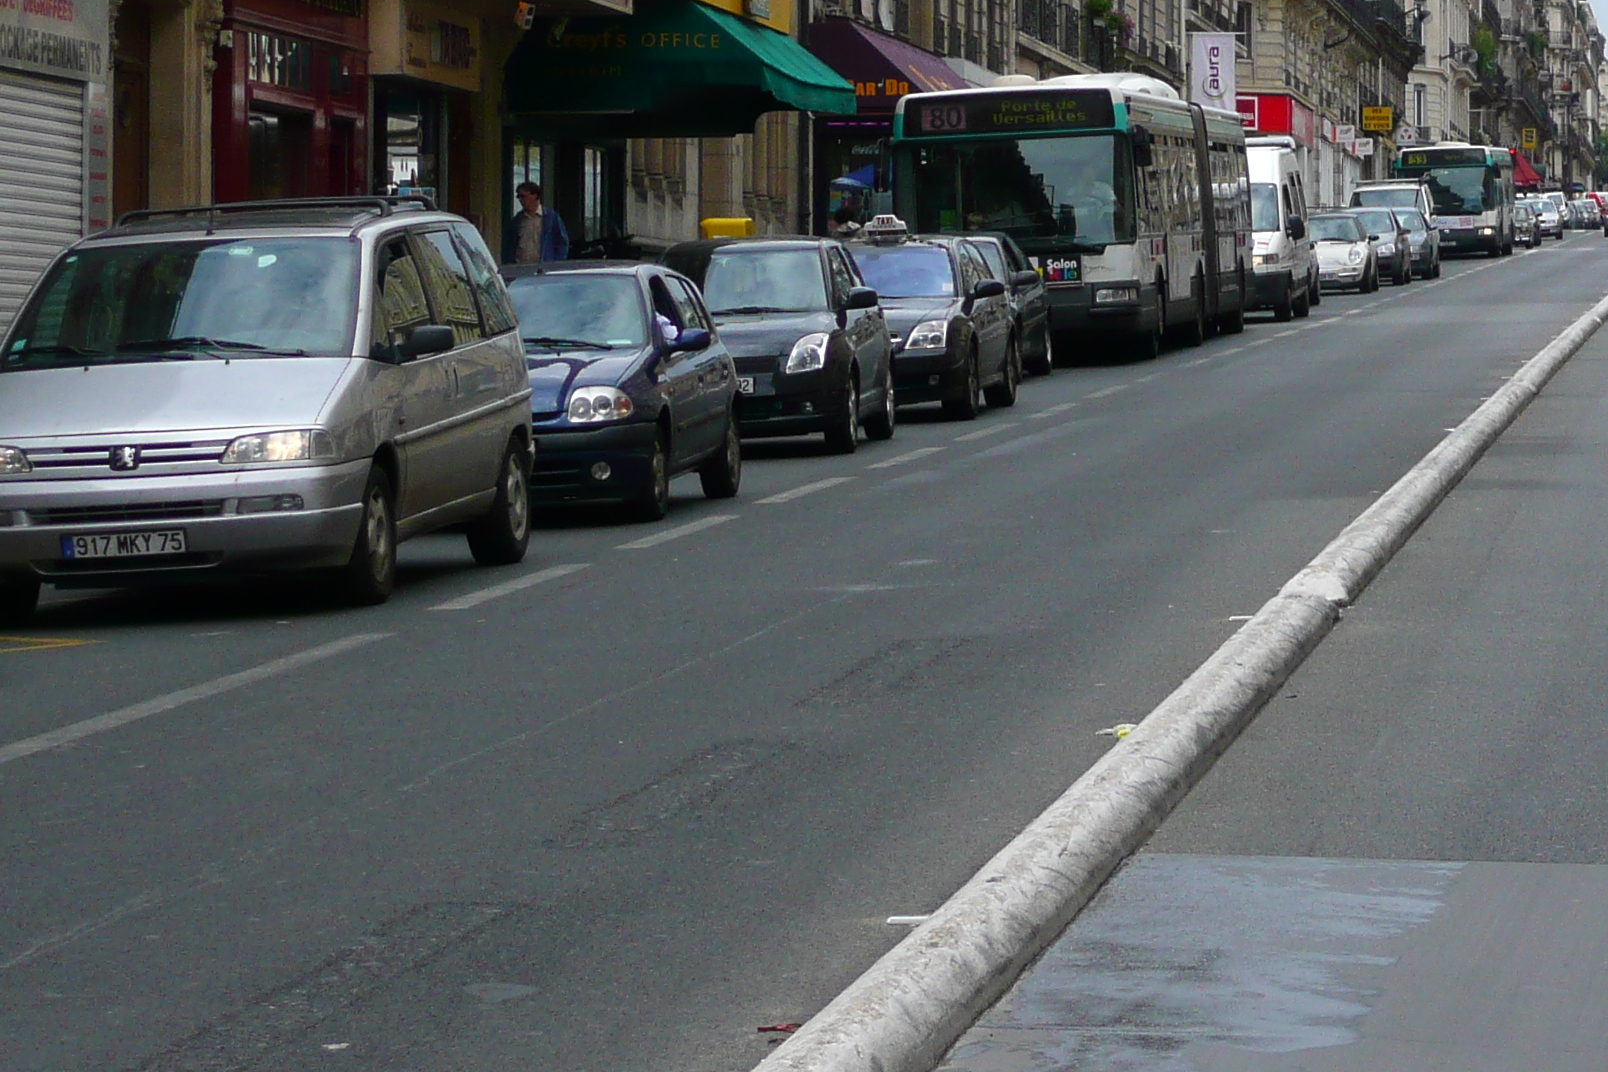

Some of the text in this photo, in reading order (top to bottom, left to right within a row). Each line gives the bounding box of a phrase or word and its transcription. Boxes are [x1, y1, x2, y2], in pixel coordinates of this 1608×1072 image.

[641, 33, 720, 49] OFFICE
[1209, 46, 1219, 90] aura
[849, 80, 876, 96] AR
[929, 100, 1076, 128] 80 Porte de
[876, 217, 893, 225] TAXI
[1047, 258, 1077, 269] Salon
[76, 532, 182, 556] 917 MKY 75
